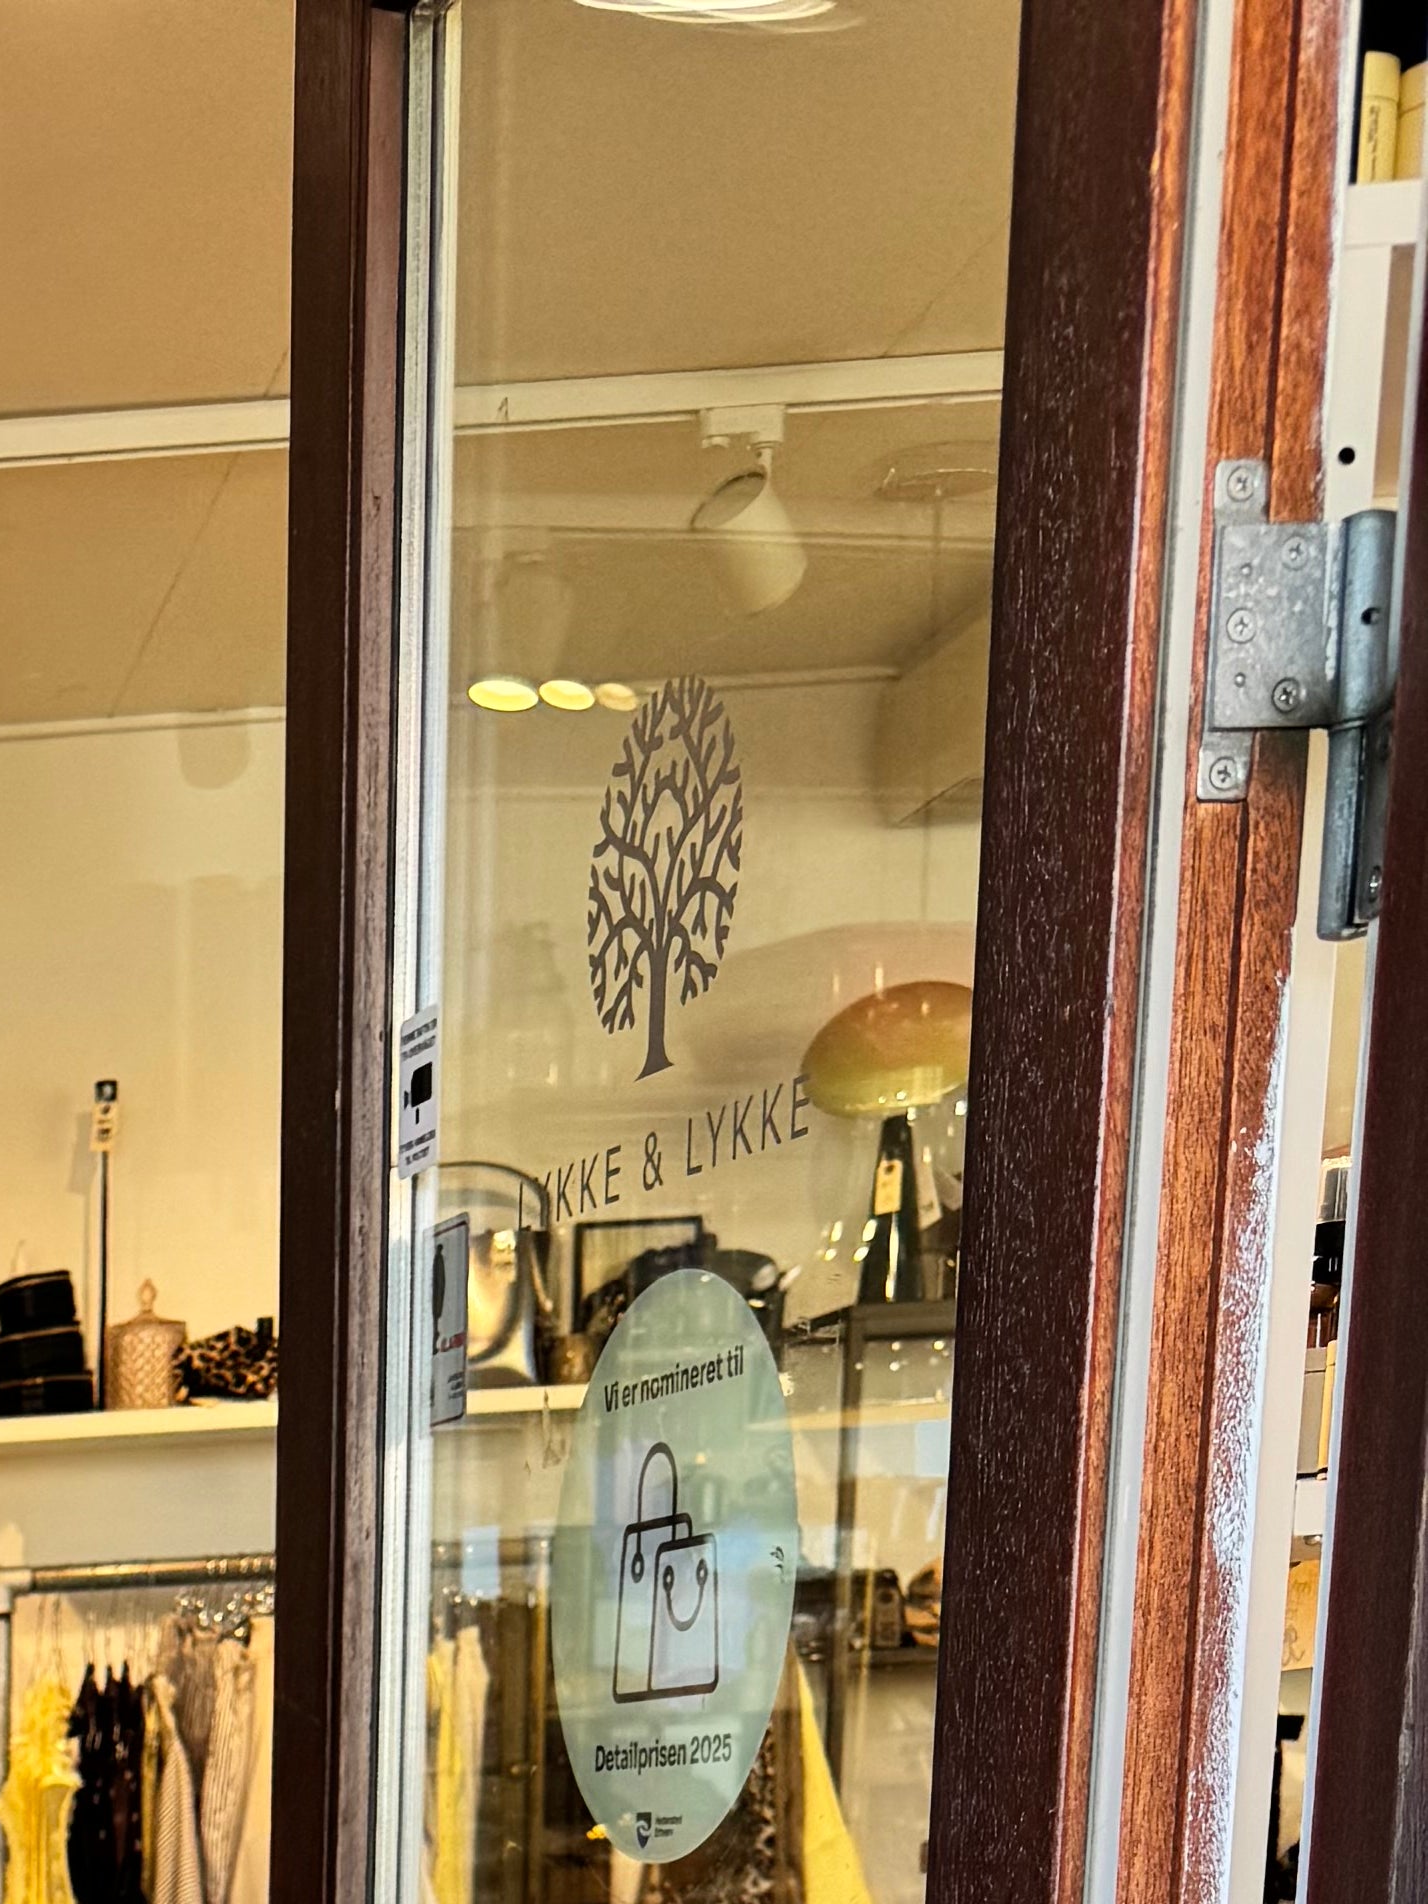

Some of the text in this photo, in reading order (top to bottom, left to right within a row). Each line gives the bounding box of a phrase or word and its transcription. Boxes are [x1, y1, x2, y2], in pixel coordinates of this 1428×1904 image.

[642, 1130, 663, 1192] &
[686, 1073, 811, 1177] LYKKE
[604, 1344, 744, 1413] Vi er nomineret til
[595, 1733, 732, 1776] Detailprisen 2025
